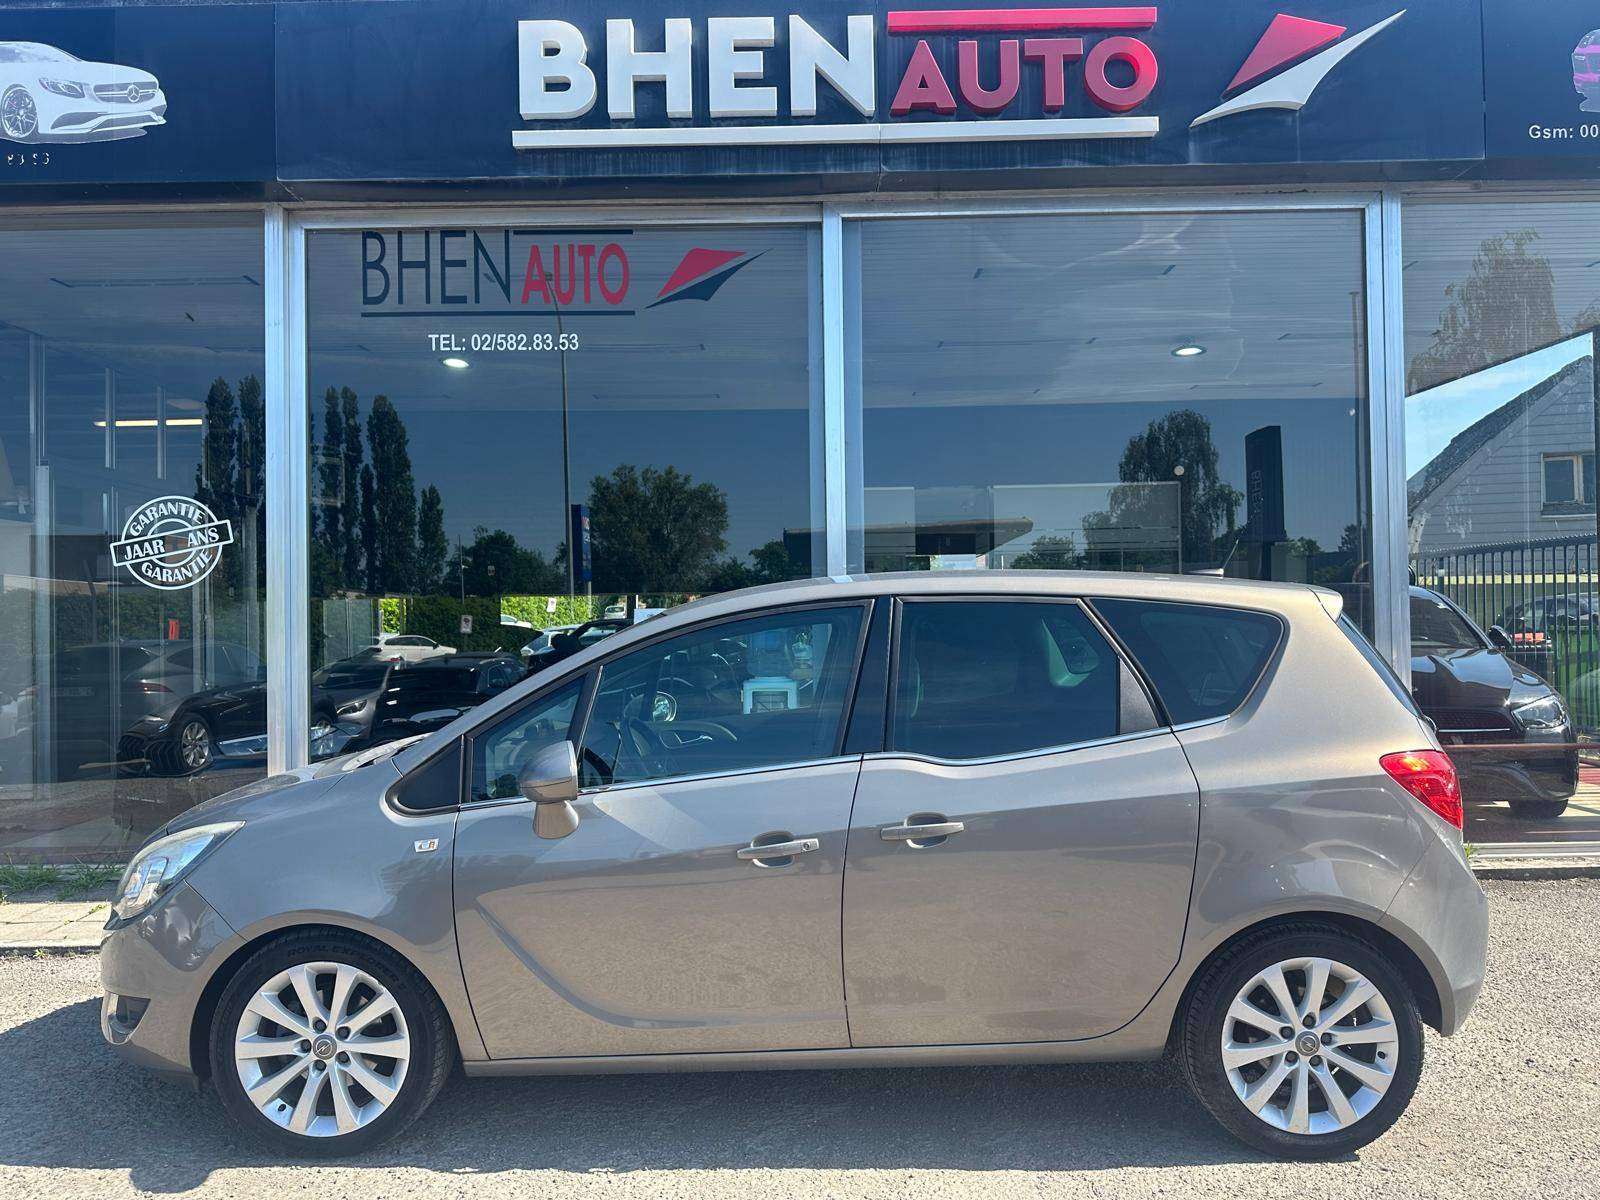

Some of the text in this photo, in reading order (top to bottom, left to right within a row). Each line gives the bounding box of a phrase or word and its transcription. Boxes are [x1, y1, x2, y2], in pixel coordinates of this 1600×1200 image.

[518, 14, 1159, 120] BHEN AUTO
[1528, 124, 1574, 139] Gsm:
[361, 229, 630, 305] BHEN AUTO
[428, 333, 579, 351] TEL: 02/582.83.53
[129, 501, 206, 537] GARANTIE
[124, 527, 220, 561] JAAR ANS
[141, 548, 213, 582] GARANTIE
